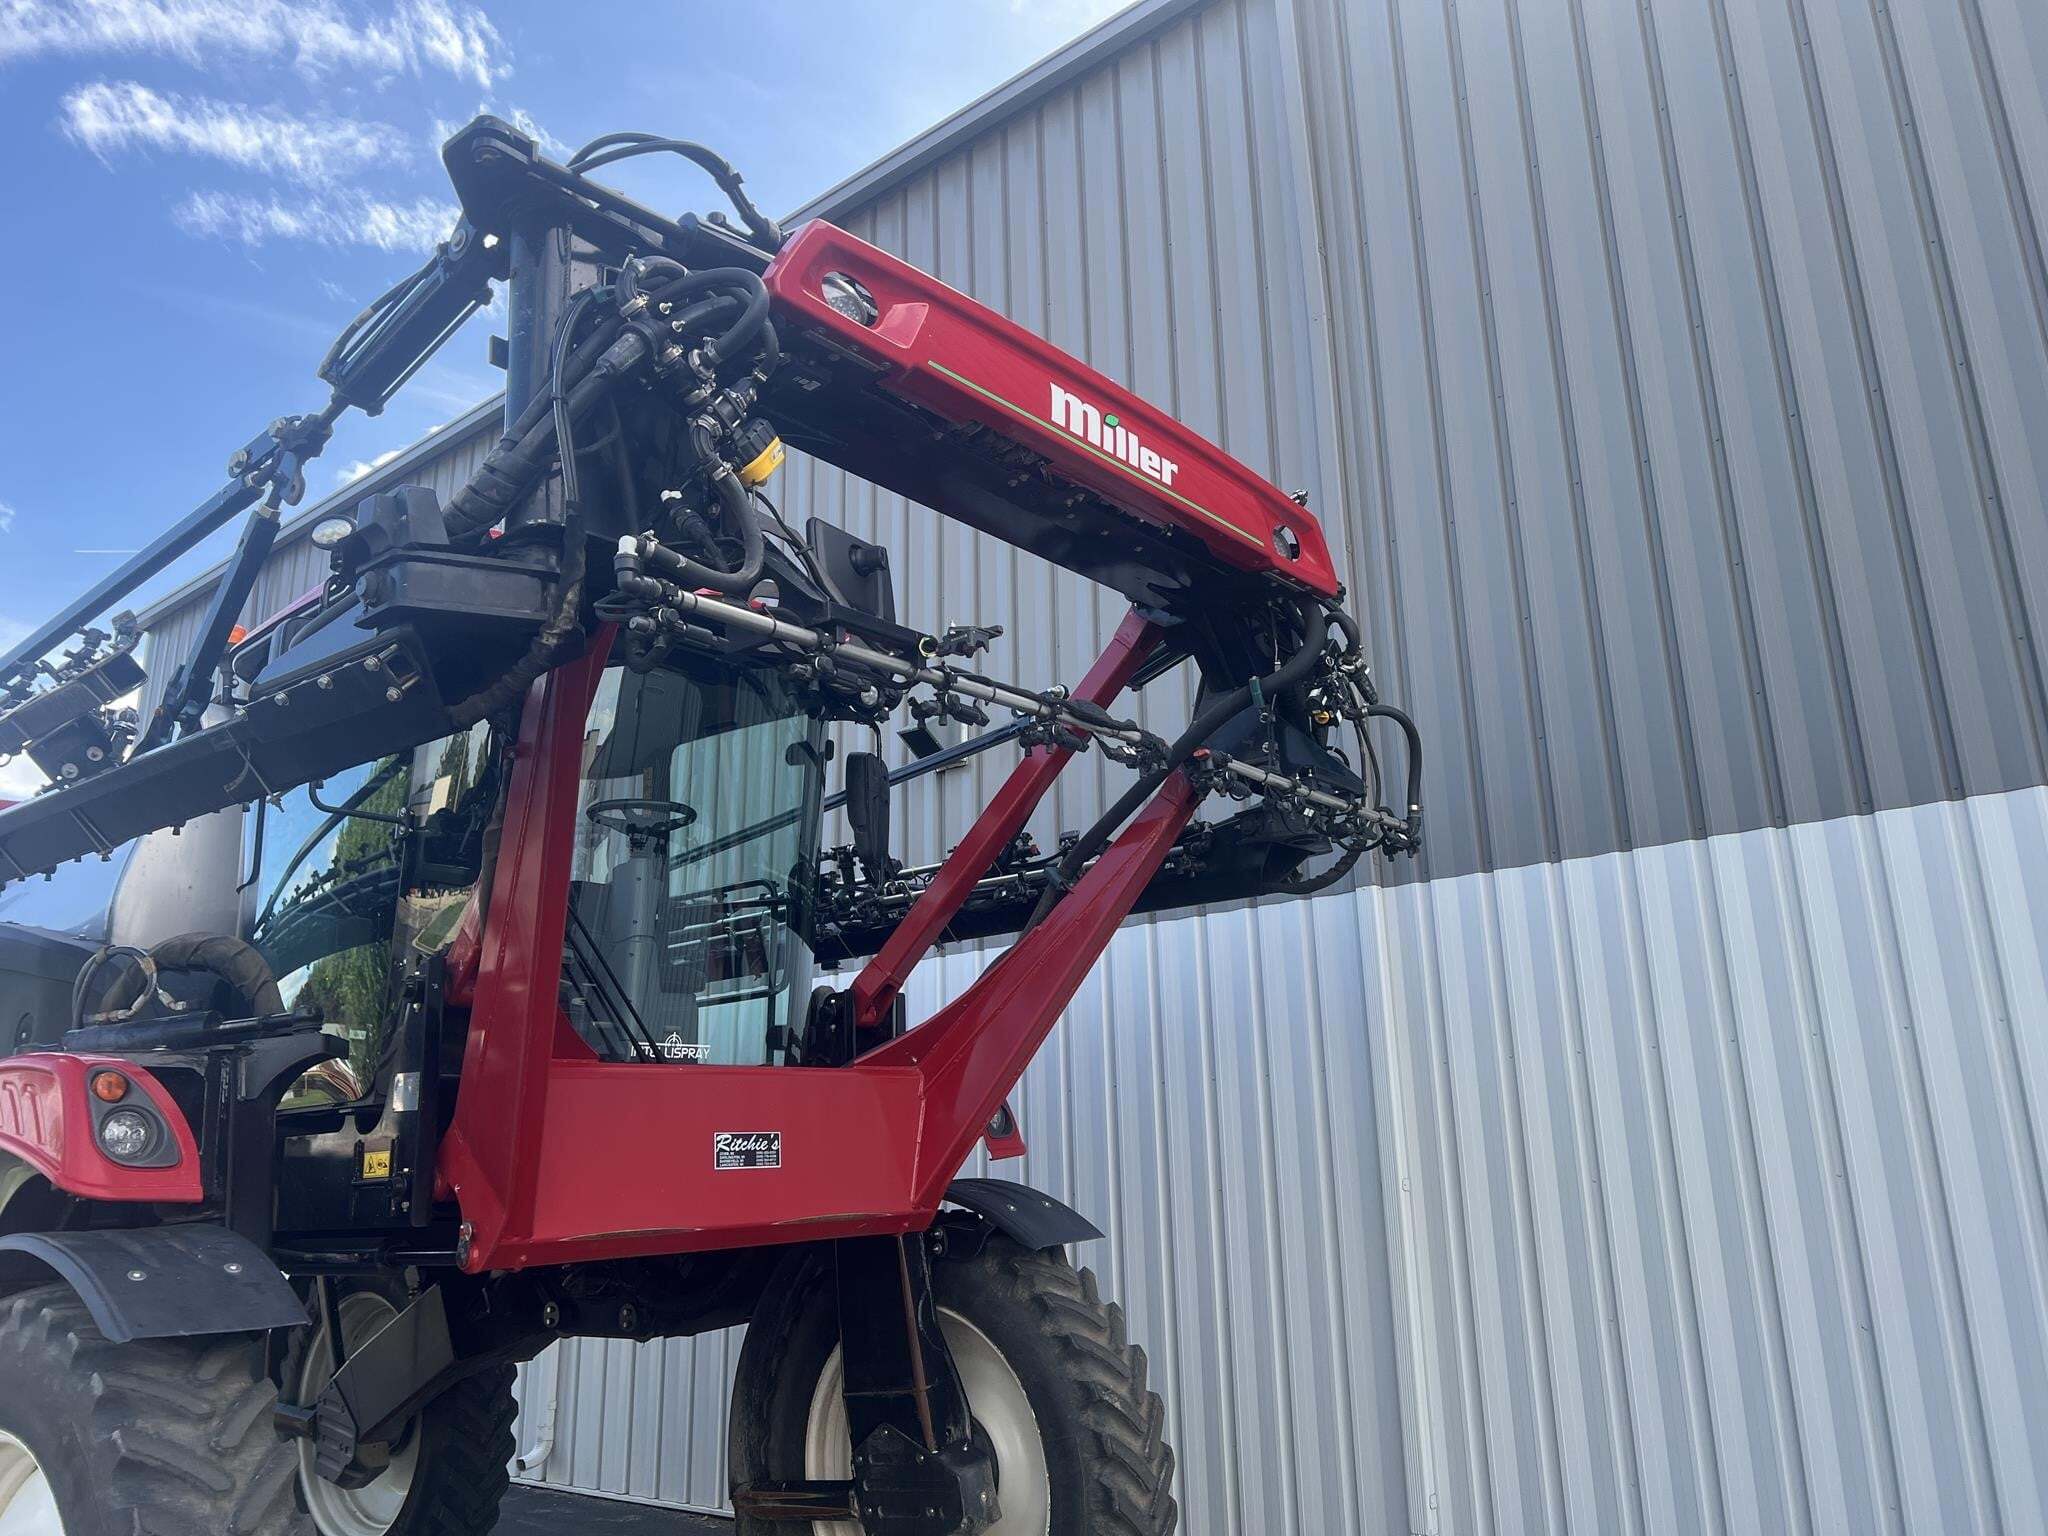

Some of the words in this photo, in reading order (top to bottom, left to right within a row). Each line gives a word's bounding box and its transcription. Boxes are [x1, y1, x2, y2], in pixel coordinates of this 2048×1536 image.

[1050, 382, 1179, 486] miller
[630, 1044, 711, 1059] ITELISPRAY
[716, 1133, 779, 1152] Ritchie's
